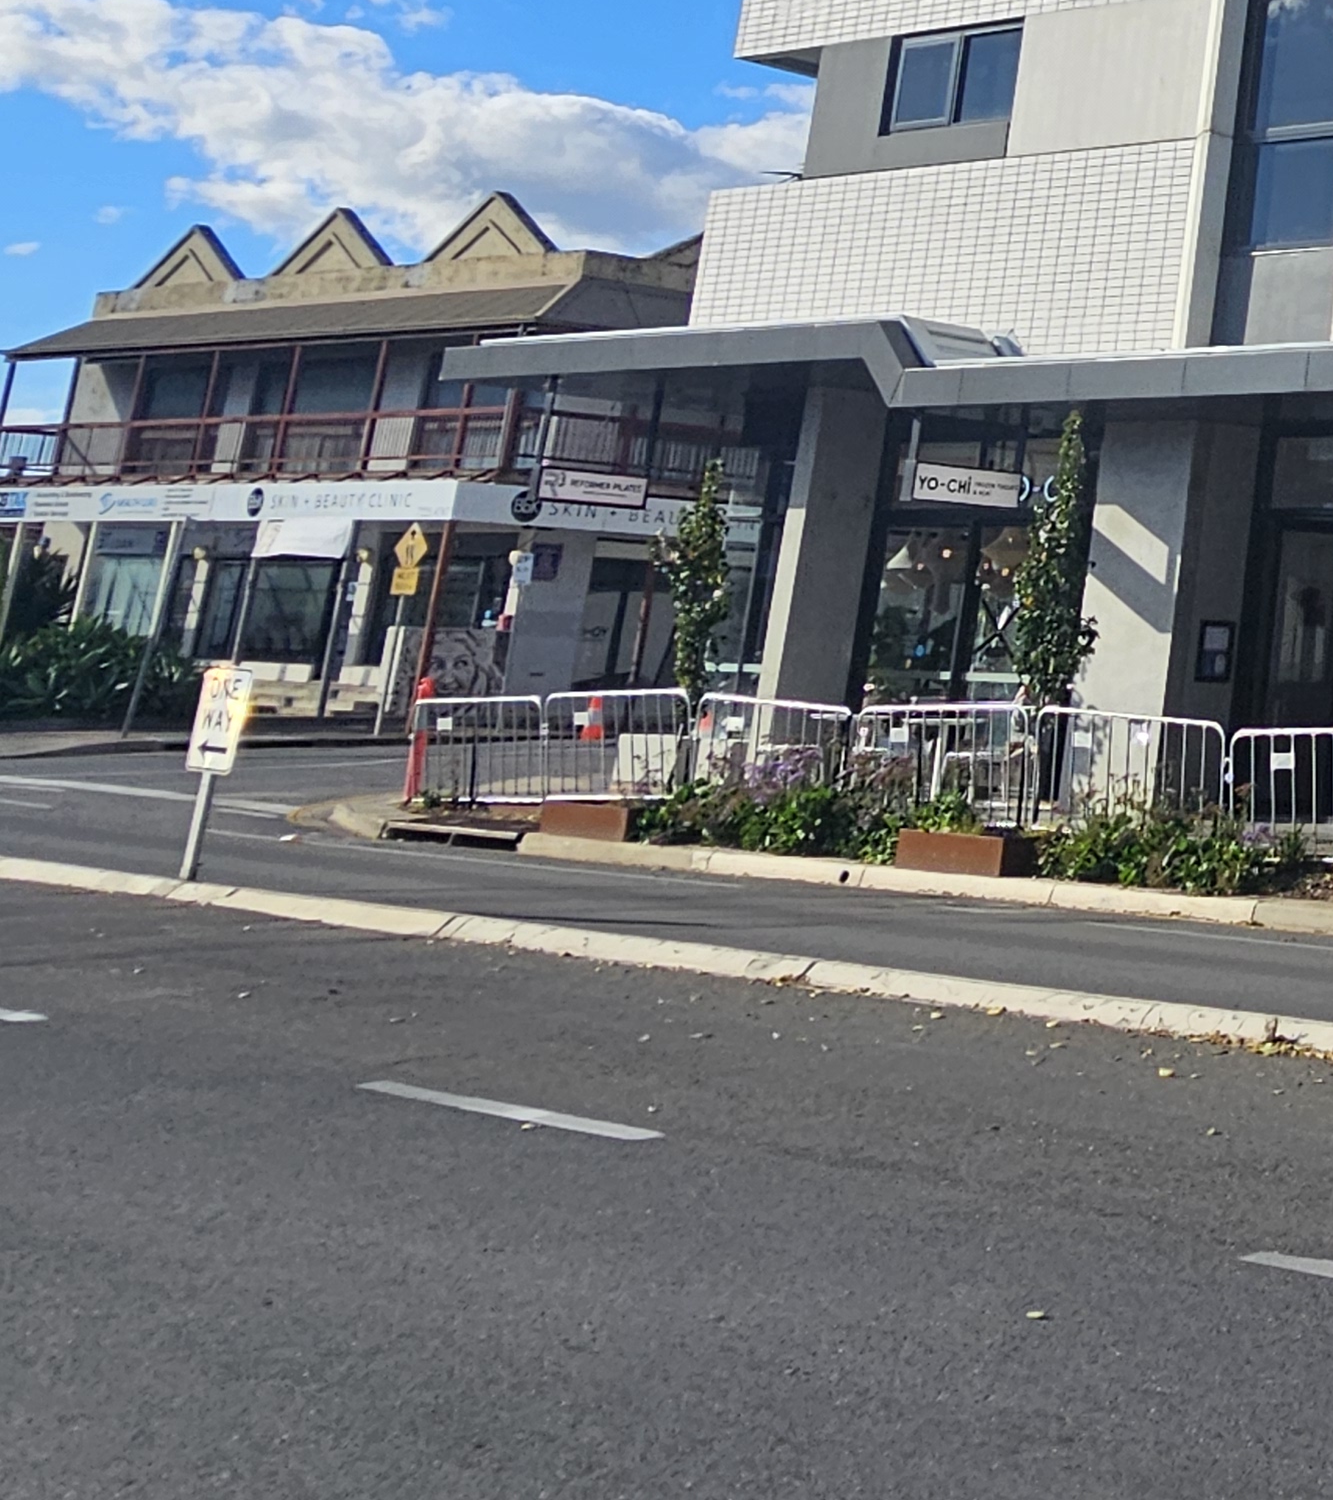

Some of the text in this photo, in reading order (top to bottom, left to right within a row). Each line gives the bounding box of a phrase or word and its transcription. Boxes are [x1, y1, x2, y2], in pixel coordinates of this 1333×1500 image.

[270, 494, 298, 509] SKIN
[314, 493, 366, 509] BEAUTY
[367, 492, 413, 508] CLINIC
[548, 502, 597, 519] SKIN
[628, 508, 682, 525] BEAU
[201, 709, 234, 733] WAY
